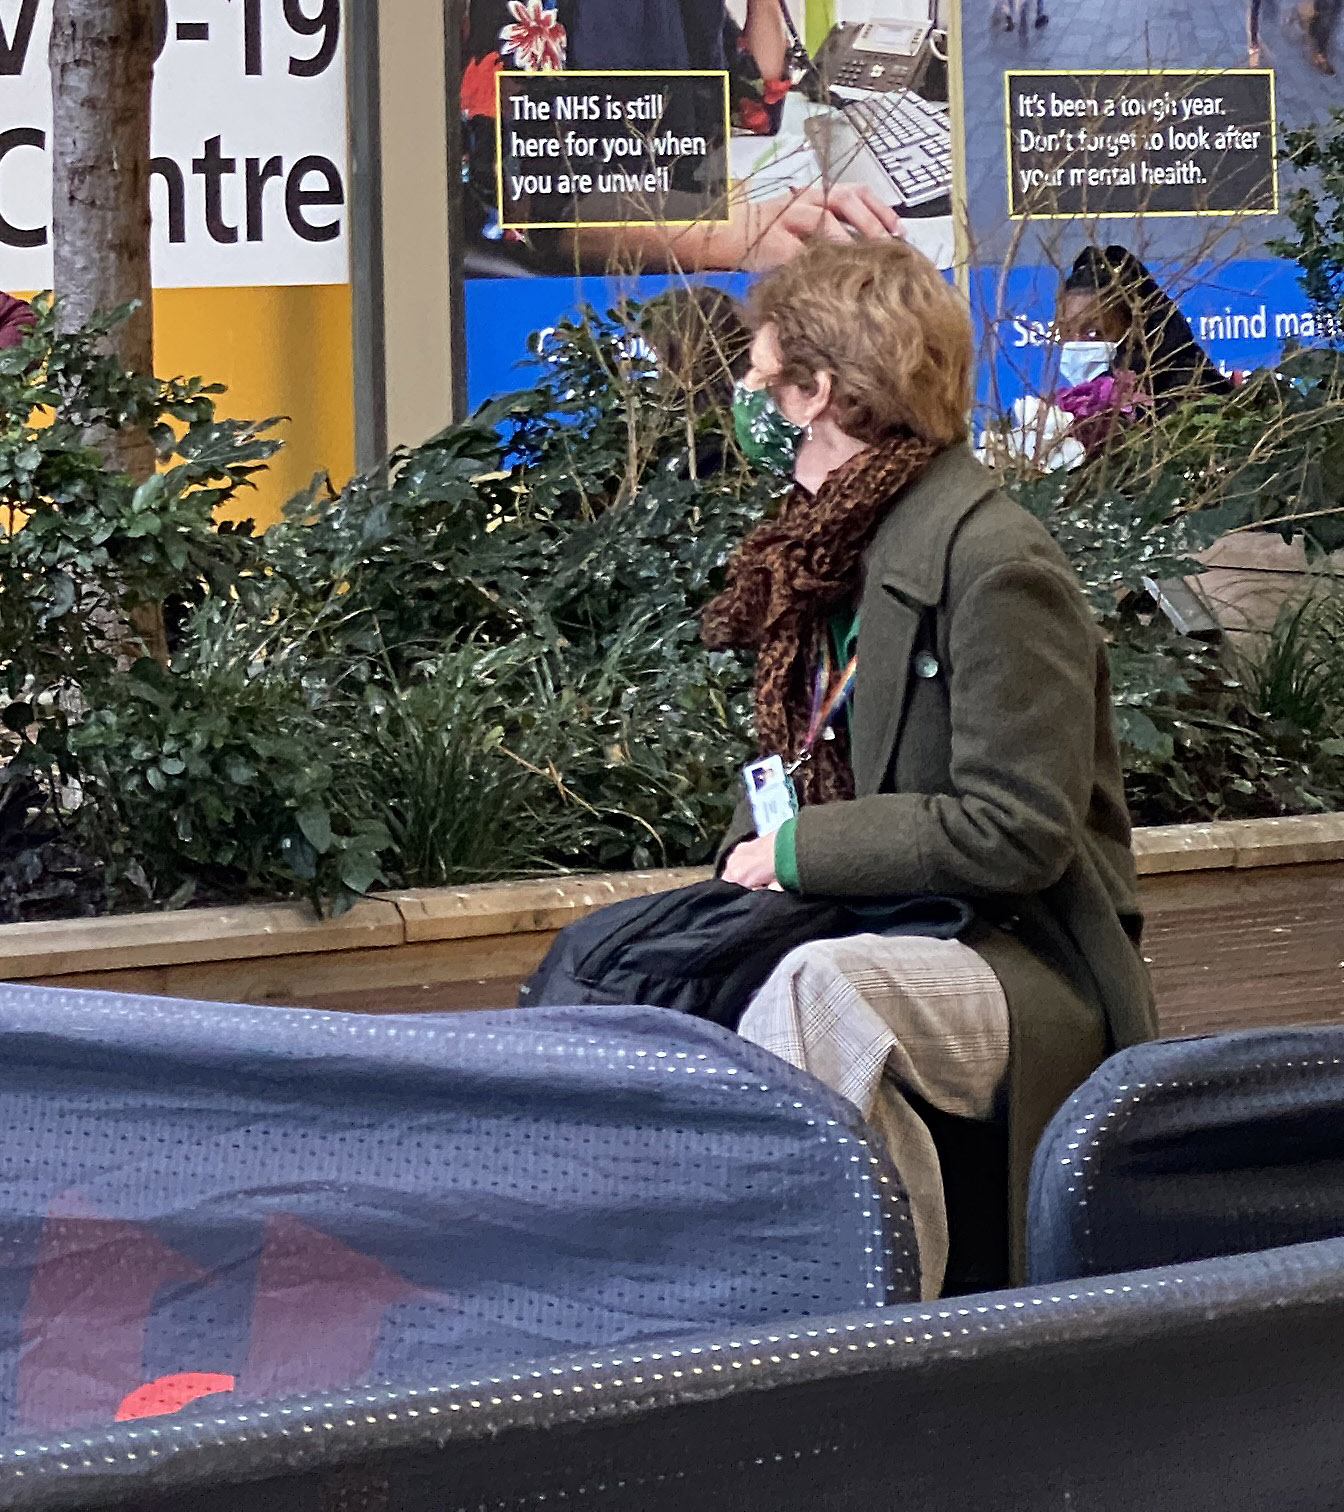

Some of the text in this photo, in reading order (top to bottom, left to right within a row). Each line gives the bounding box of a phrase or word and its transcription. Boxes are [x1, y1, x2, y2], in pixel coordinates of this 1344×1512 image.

[510, 94, 663, 121] The NHS is still
[1051, 92, 1098, 117] been
[1181, 97, 1226, 120] year.
[512, 130, 707, 162] here for you when
[1144, 131, 1164, 150] o
[1169, 125, 1211, 151] look
[1215, 124, 1261, 151] after
[512, 174, 551, 200] you
[558, 173, 592, 194] are
[1200, 305, 1266, 340] mind
